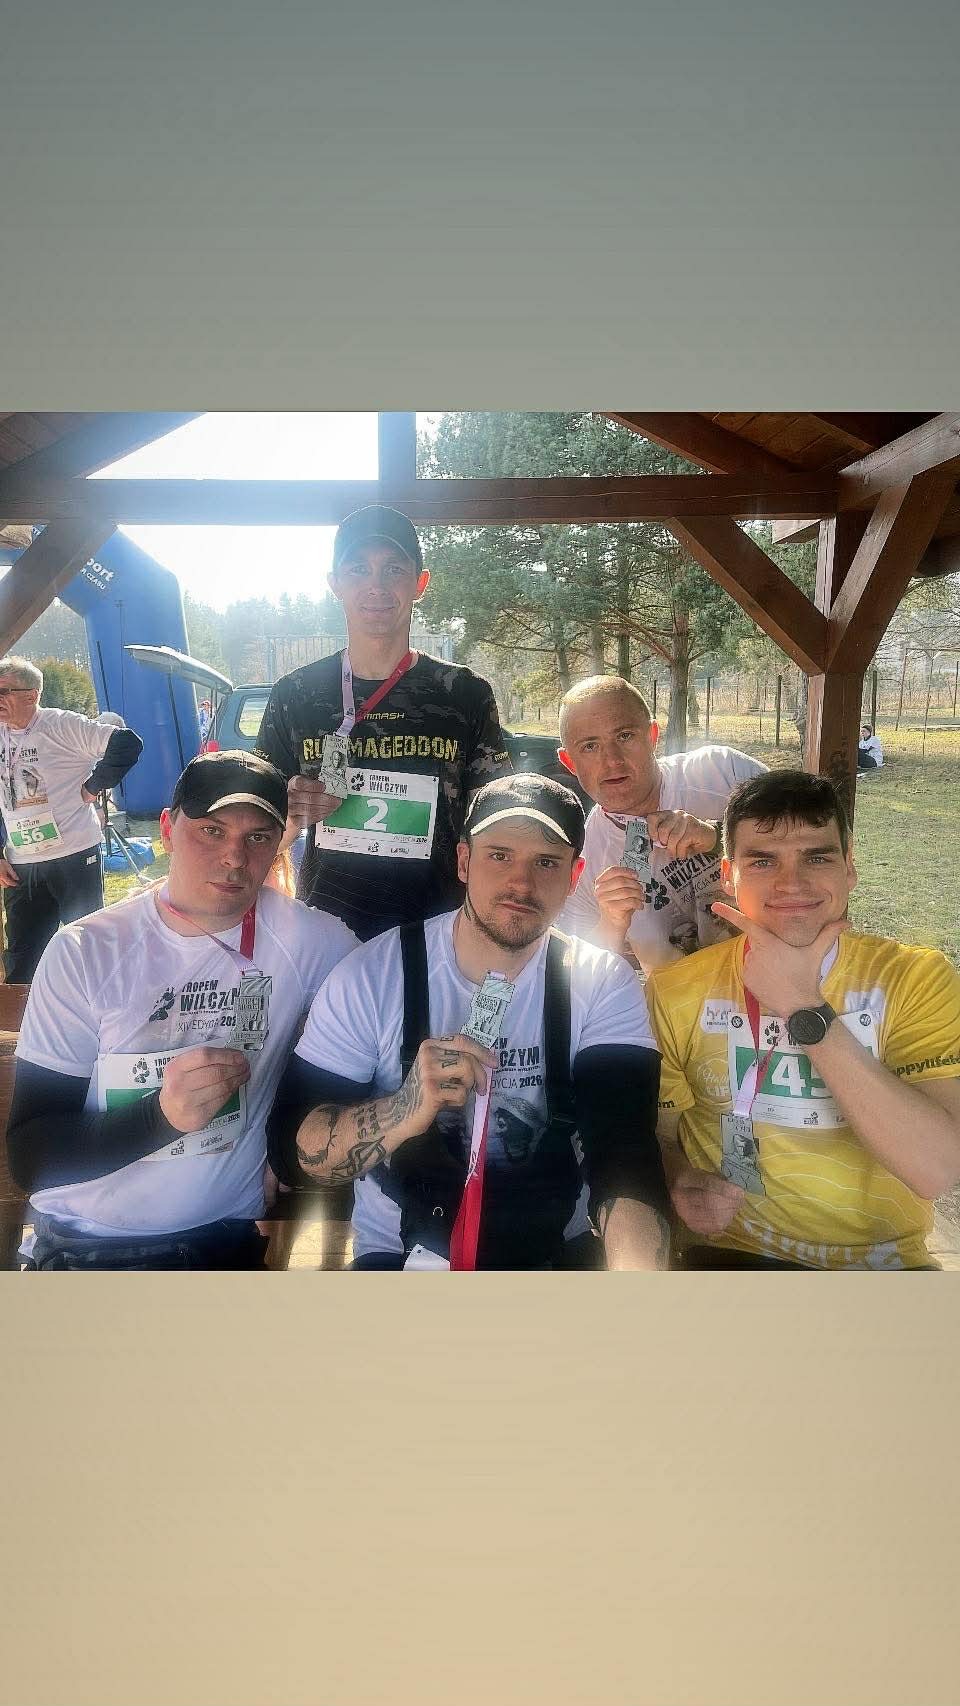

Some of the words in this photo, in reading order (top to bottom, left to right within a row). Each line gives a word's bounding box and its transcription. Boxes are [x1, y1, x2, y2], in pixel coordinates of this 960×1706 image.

[363, 712, 405, 720] MMASH
[303, 736, 459, 761] RUMAGEDDON
[369, 781, 408, 795] WILCZYM
[363, 798, 389, 832] 2
[20, 827, 46, 845] 56
[181, 980, 219, 993] TROPEM
[220, 1015, 237, 1027] 202
[500, 1045, 541, 1068] CZYM
[491, 1076, 518, 1089] DYCJA
[519, 1074, 544, 1089] 2026
